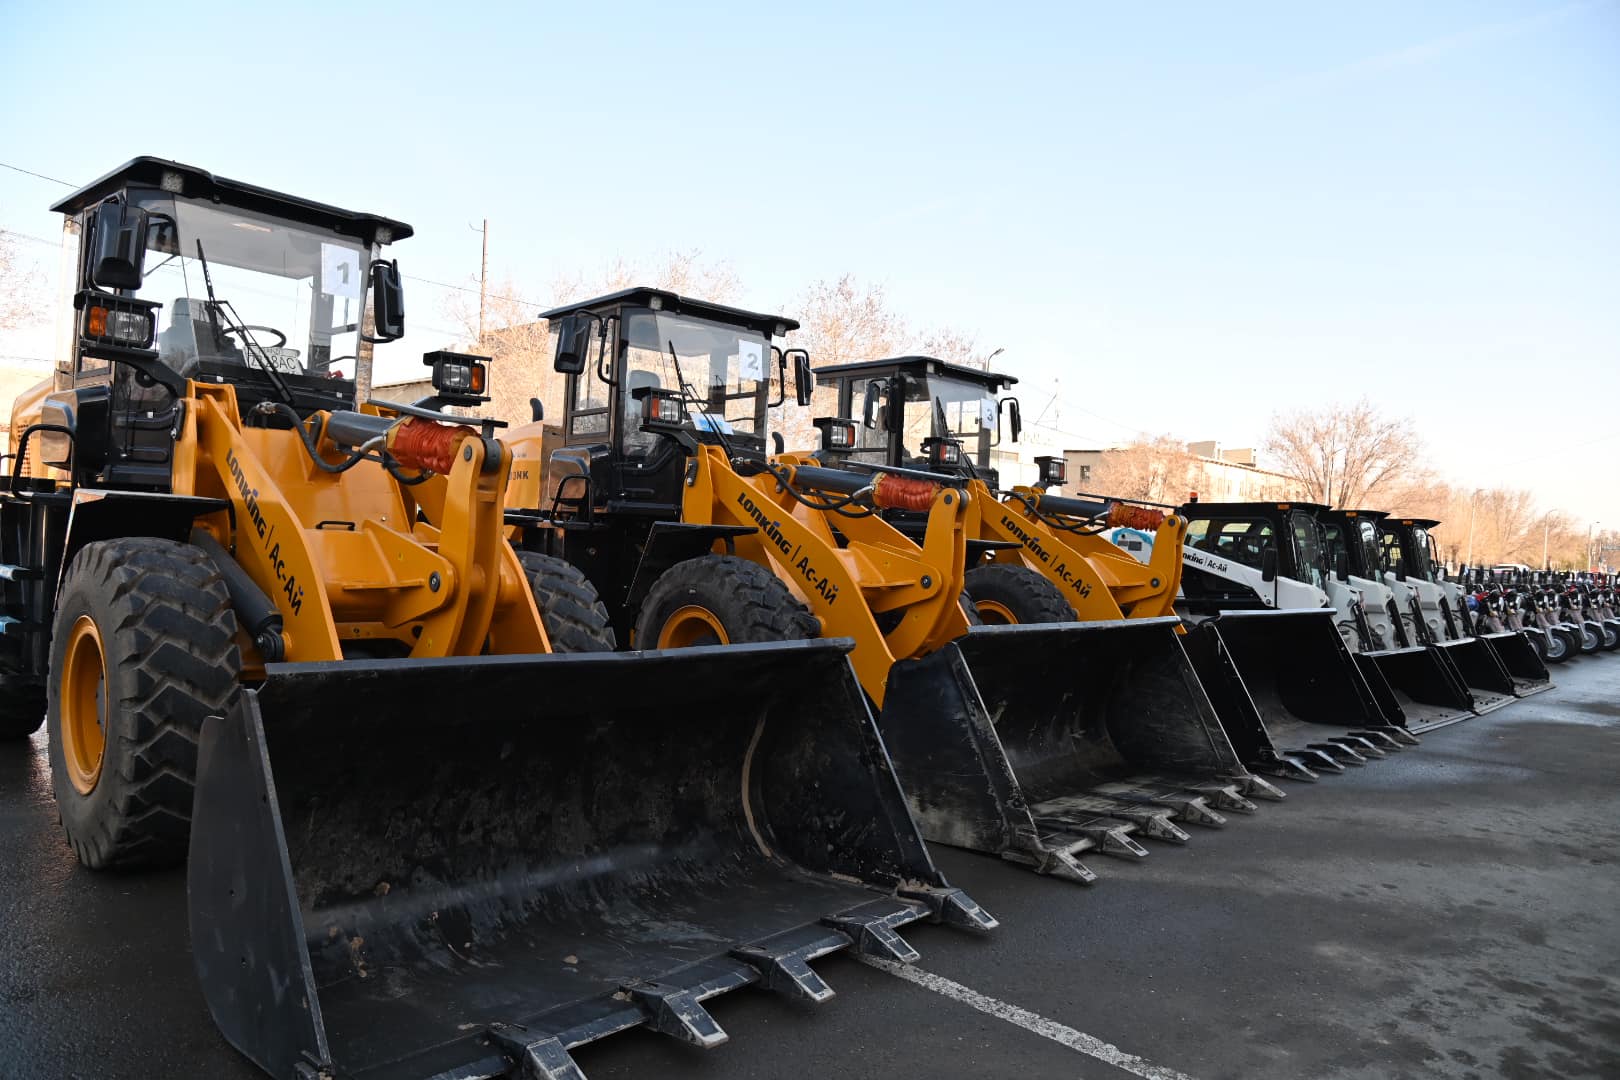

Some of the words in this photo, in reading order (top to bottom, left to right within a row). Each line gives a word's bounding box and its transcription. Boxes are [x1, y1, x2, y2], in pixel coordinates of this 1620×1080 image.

[337, 262, 349, 284] 1
[747, 353, 758, 370] 2
[987, 408, 993, 421] 3
[269, 543, 304, 616] Ас-Ай
[796, 556, 839, 605] Ас-Ай
[1054, 563, 1092, 599] Ас-Ай
